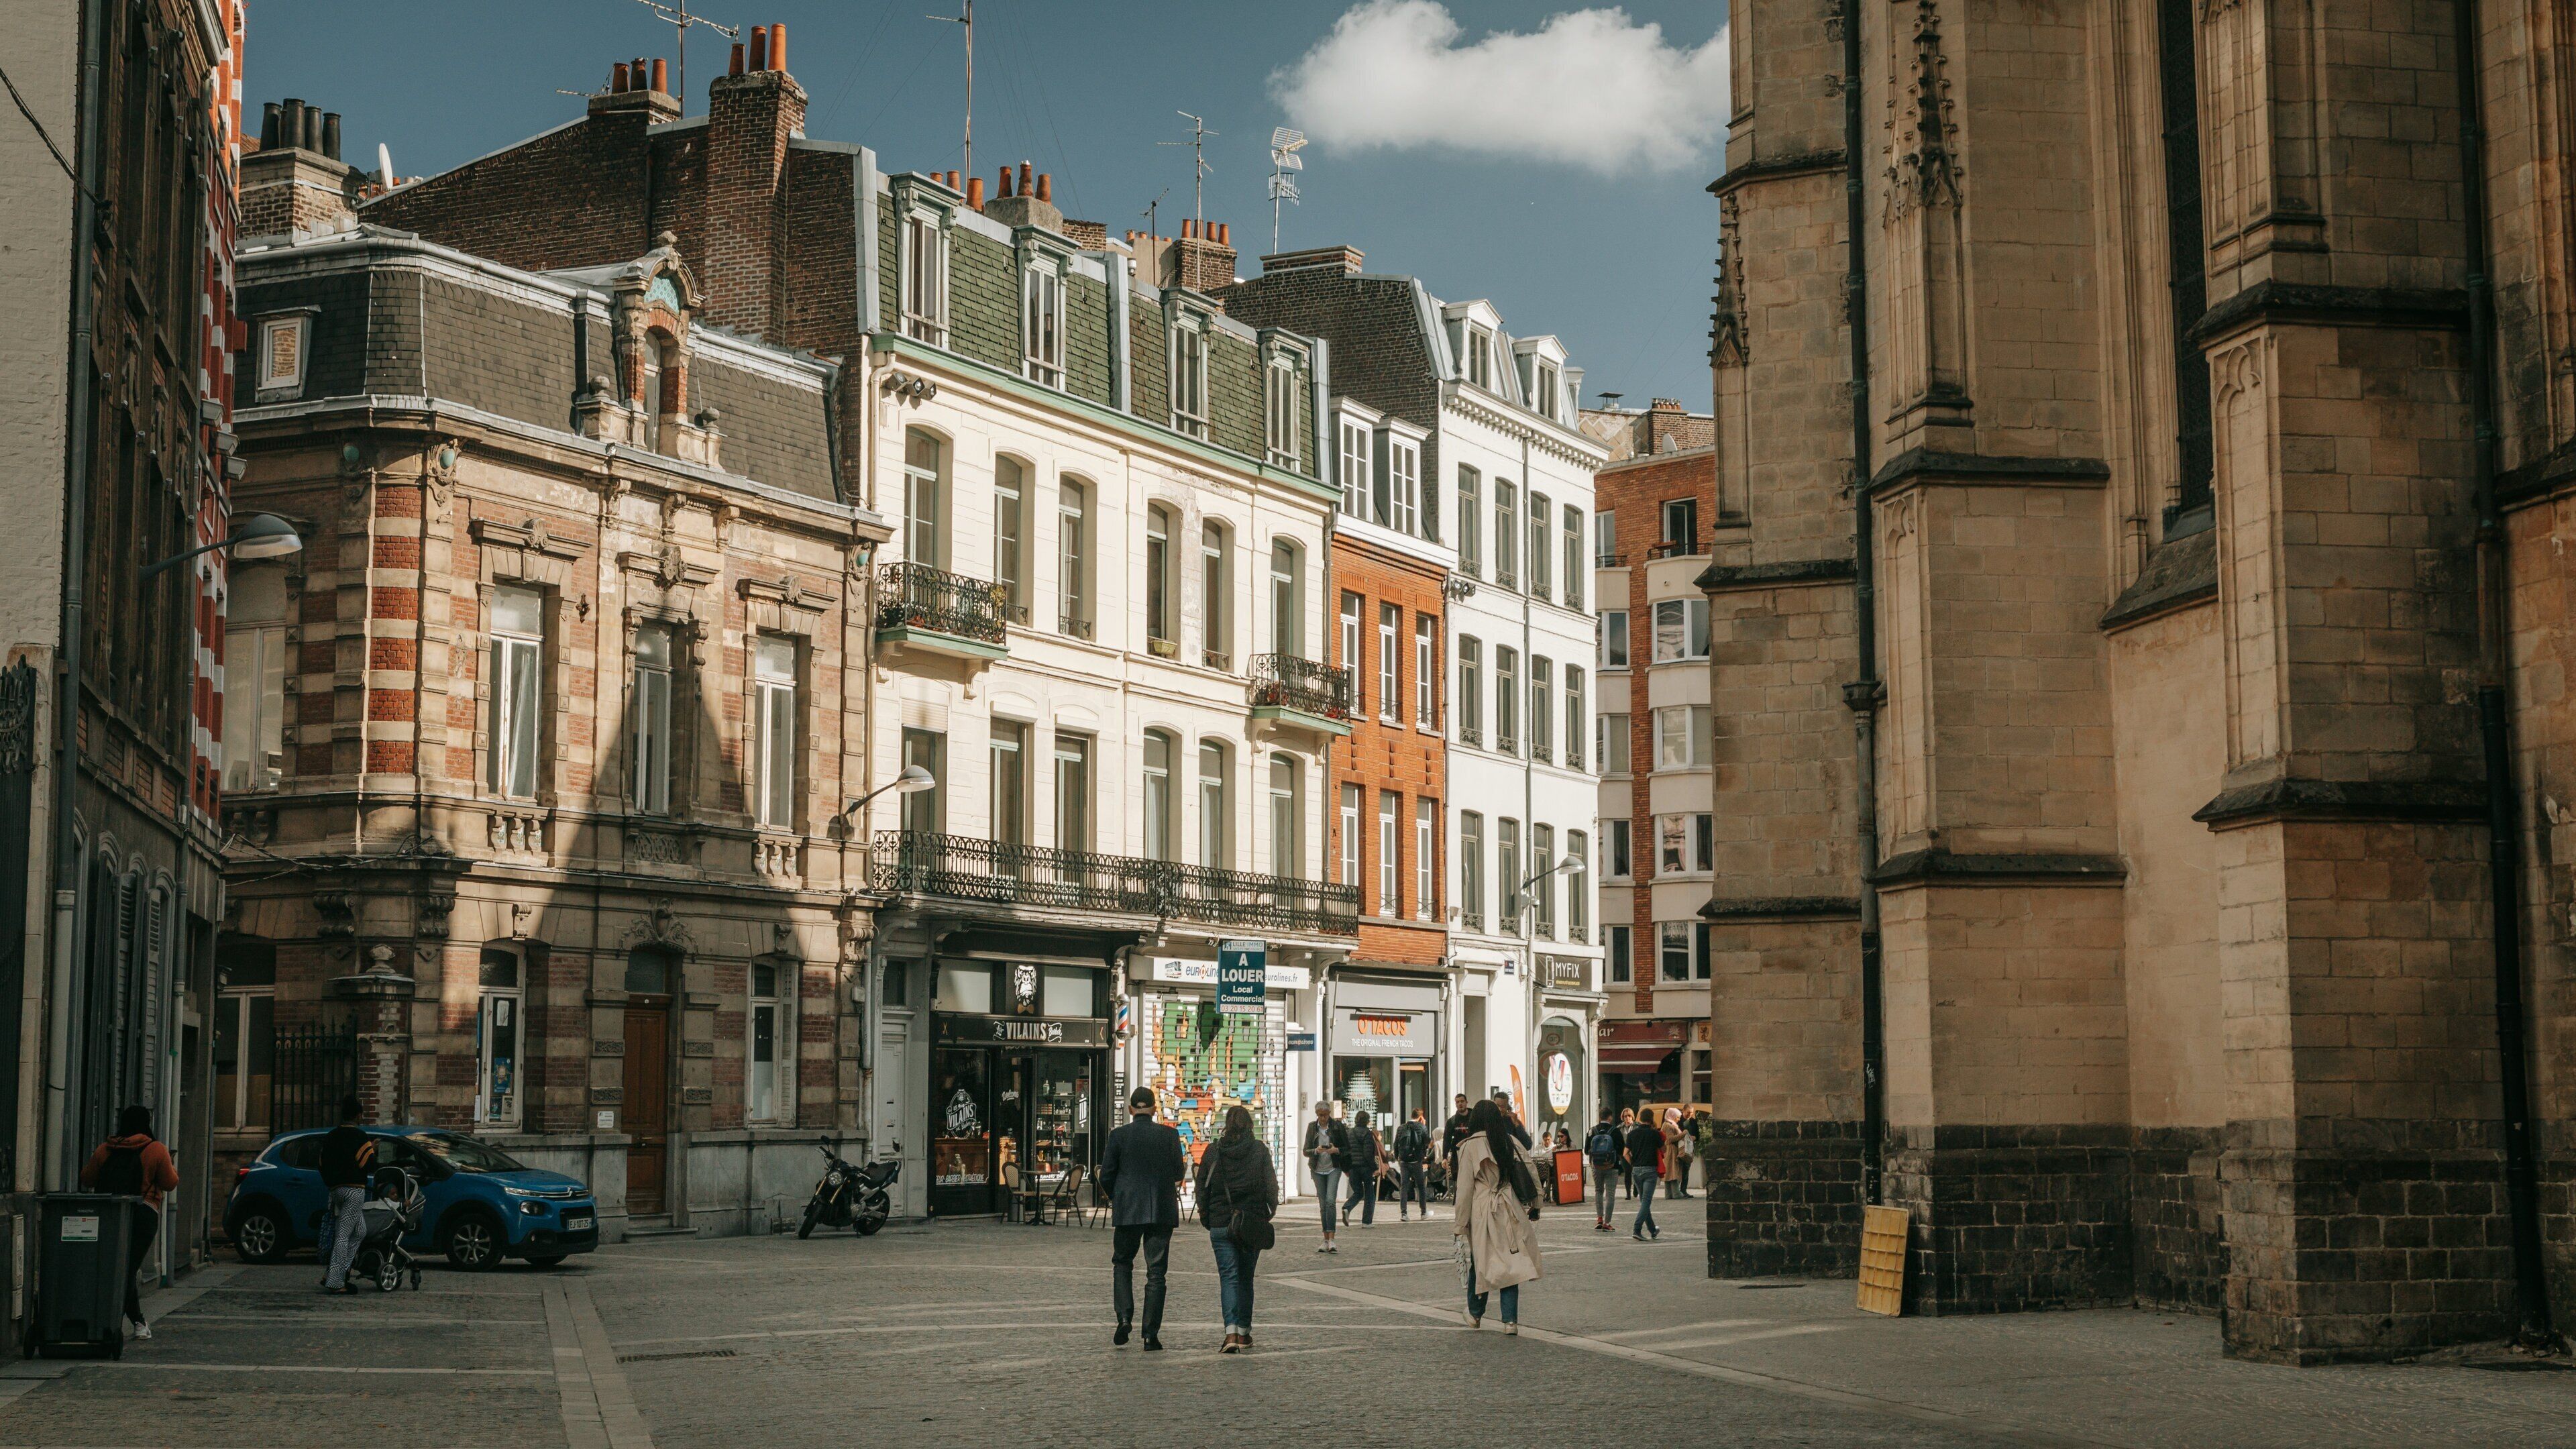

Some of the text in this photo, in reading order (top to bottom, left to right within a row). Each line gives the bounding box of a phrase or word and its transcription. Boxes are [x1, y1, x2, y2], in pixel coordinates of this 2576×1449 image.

[1238, 953, 1248, 966] A
[1222, 969, 1264, 983] LOUER
[1556, 962, 1580, 979] MYFIX
[1232, 985, 1253, 994] Local
[1221, 994, 1265, 1003] Commercial
[1006, 1022, 1047, 1040] VILAINS
[1048, 1026, 1063, 1037] Barber
[1599, 1028, 1615, 1037] ar
[1352, 1038, 1413, 1048] THE ORIGINAL FRENCH TACOS
[949, 1104, 974, 1128] VILAINS
[1561, 1173, 1578, 1181] O'TACOS
